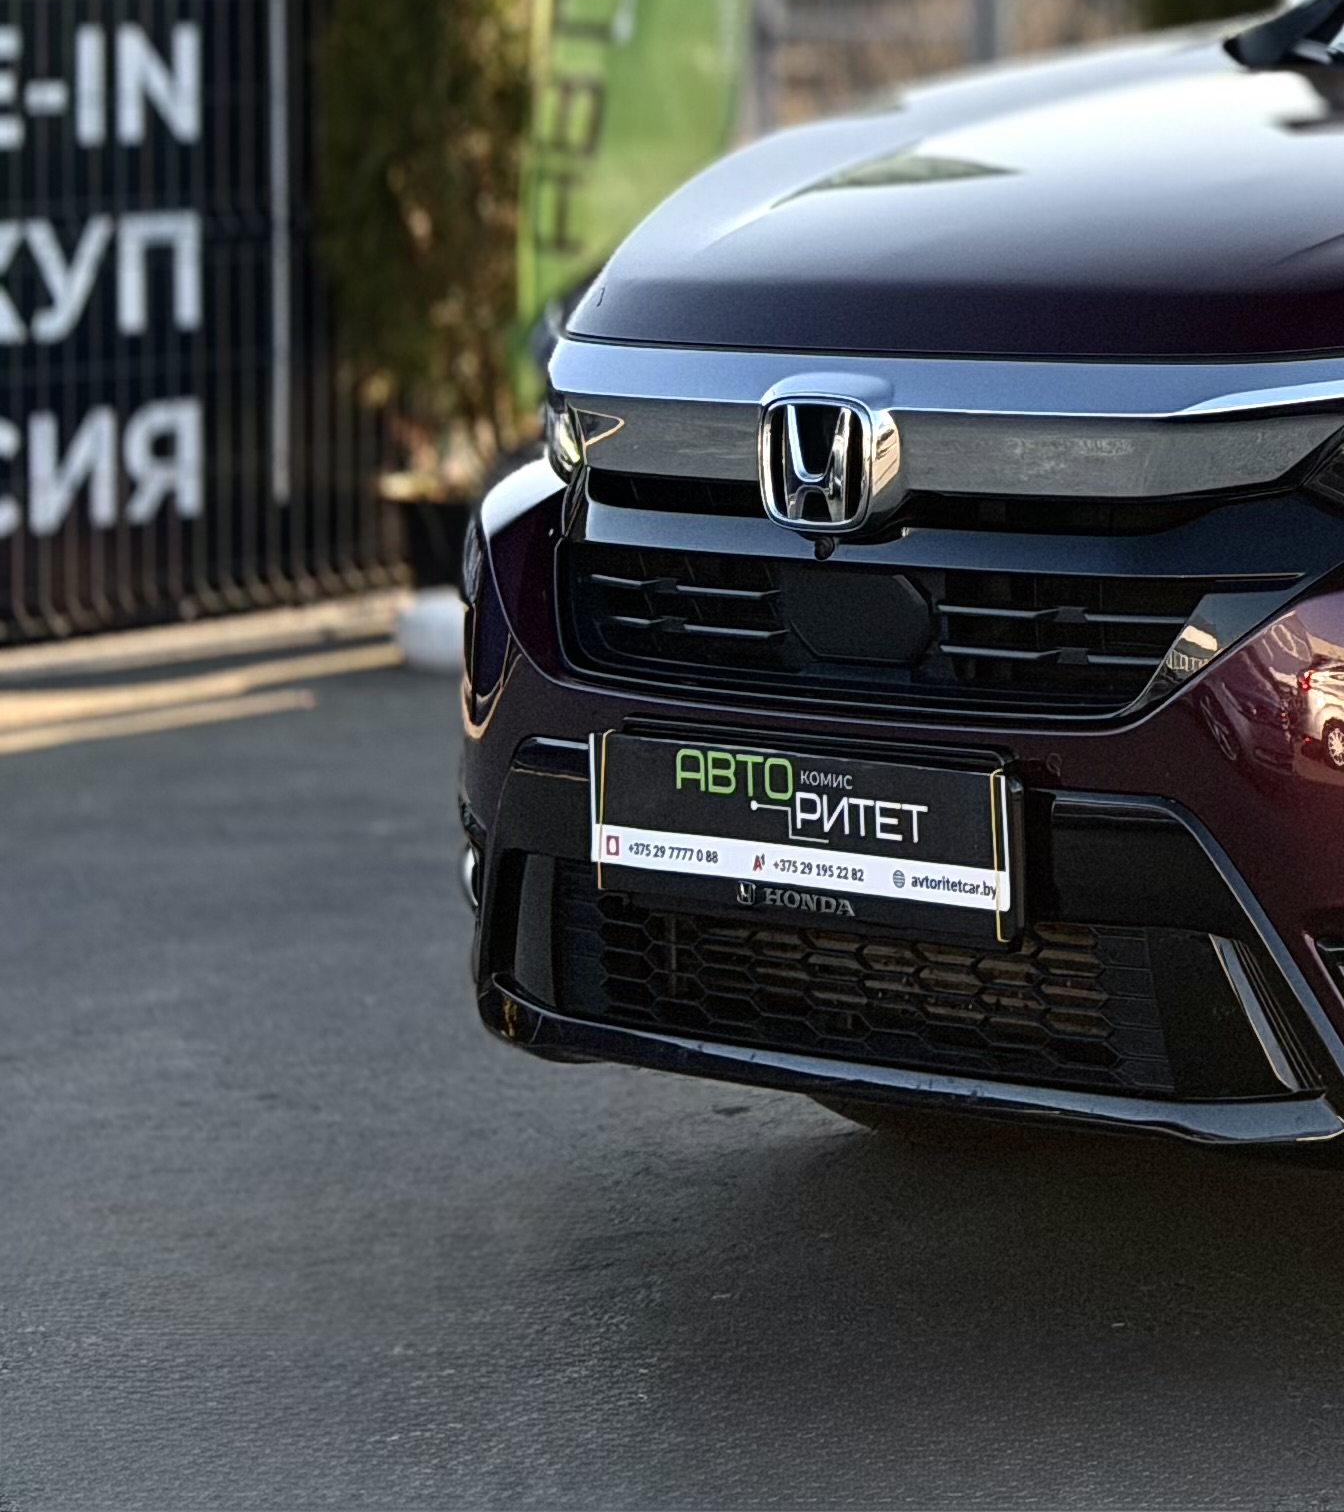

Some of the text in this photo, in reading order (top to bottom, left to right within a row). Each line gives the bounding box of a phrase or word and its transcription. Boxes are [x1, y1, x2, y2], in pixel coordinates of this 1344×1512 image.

[676, 748, 793, 800] АВТО
[800, 770, 853, 790] КОМИС
[796, 791, 928, 843] РИТЕТ
[628, 842, 651, 856] +375
[653, 845, 666, 858] 29
[669, 847, 694, 861] 7777
[773, 859, 798, 873] +375
[800, 862, 812, 875] 29
[836, 866, 849, 880] 22
[911, 874, 997, 900] avtoritetcar.by
[764, 888, 855, 917] HONDA
